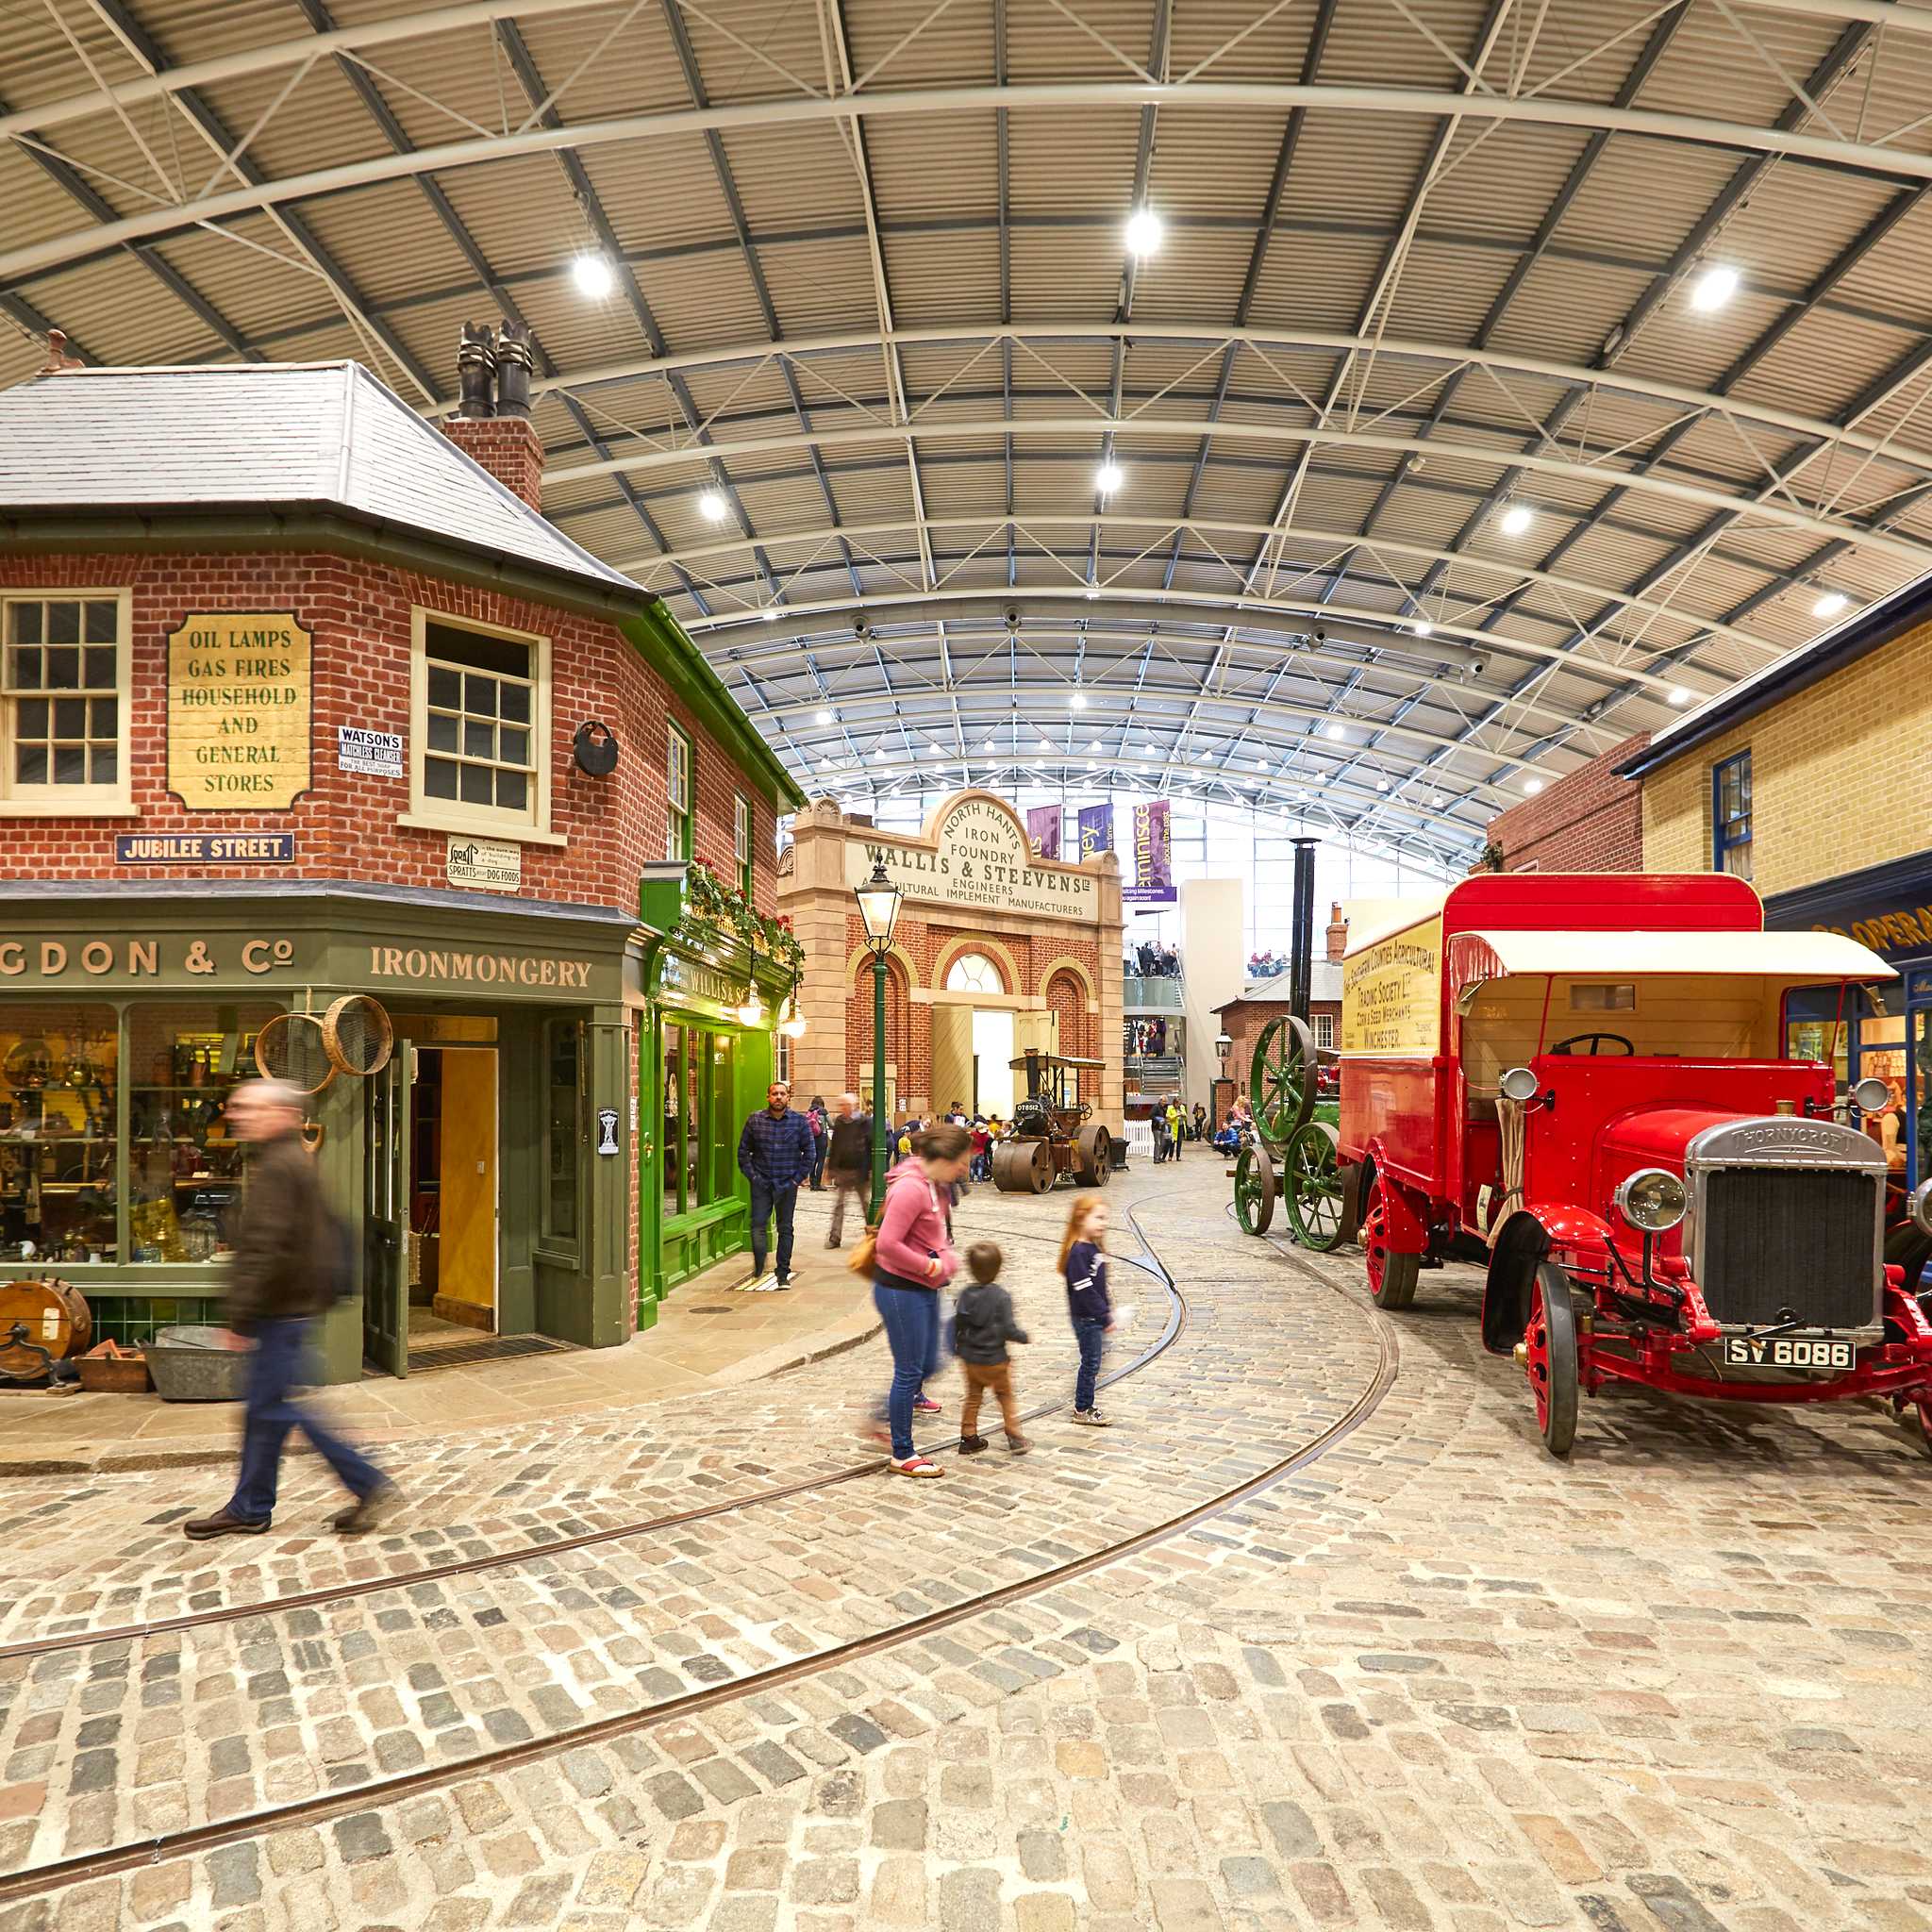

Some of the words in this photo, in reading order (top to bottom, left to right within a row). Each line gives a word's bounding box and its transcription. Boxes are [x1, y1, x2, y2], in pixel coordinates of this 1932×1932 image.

[190, 631, 221, 648] OIL
[230, 631, 291, 648] LAMPS
[188, 659, 226, 677] GAS
[236, 659, 291, 679] FIRES
[182, 688, 296, 706] HOUSEHOLD
[218, 717, 258, 734] AND
[342, 728, 399, 748] WATSON'S
[196, 746, 280, 764] GENERAL
[341, 742, 373, 759] MATCHLESS
[374, 748, 401, 764] CLEANSER
[205, 774, 274, 792] STORES
[944, 804, 981, 839] NORTH
[986, 807, 1021, 850] HANTS
[965, 827, 999, 844] IRON
[125, 839, 203, 858] JUBILEE
[210, 839, 288, 858] STREET.
[951, 844, 1015, 865] FOUNDRY
[1136, 805, 1151, 887] eminisce
[487, 869, 501, 880] DOG
[501, 871, 520, 883] FOODS
[864, 844, 950, 874] WALLIS
[962, 861, 973, 877] &
[985, 864, 1081, 893] STEEVENS
[861, 876, 940, 897] AULTURAL
[947, 889, 1000, 906] IMPLEMENT
[1008, 898, 1084, 916] MANUFACTURERS
[952, 878, 1013, 895] ENGINEERS
[0, 941, 158, 974] GDON
[185, 941, 215, 974] &
[370, 946, 592, 988] IRONMONGERY
[1372, 945, 1392, 972] COUNTIES
[1394, 939, 1435, 974] AGRICULTURAL
[691, 970, 727, 1002] WILLIS
[1358, 986, 1377, 1008] TRADING
[1378, 980, 1401, 1005] SOCIETY
[1731, 1127, 1855, 1152] THORNYCROFT
[1731, 1339, 1767, 1363] SV
[1774, 1341, 1849, 1367] 6086
